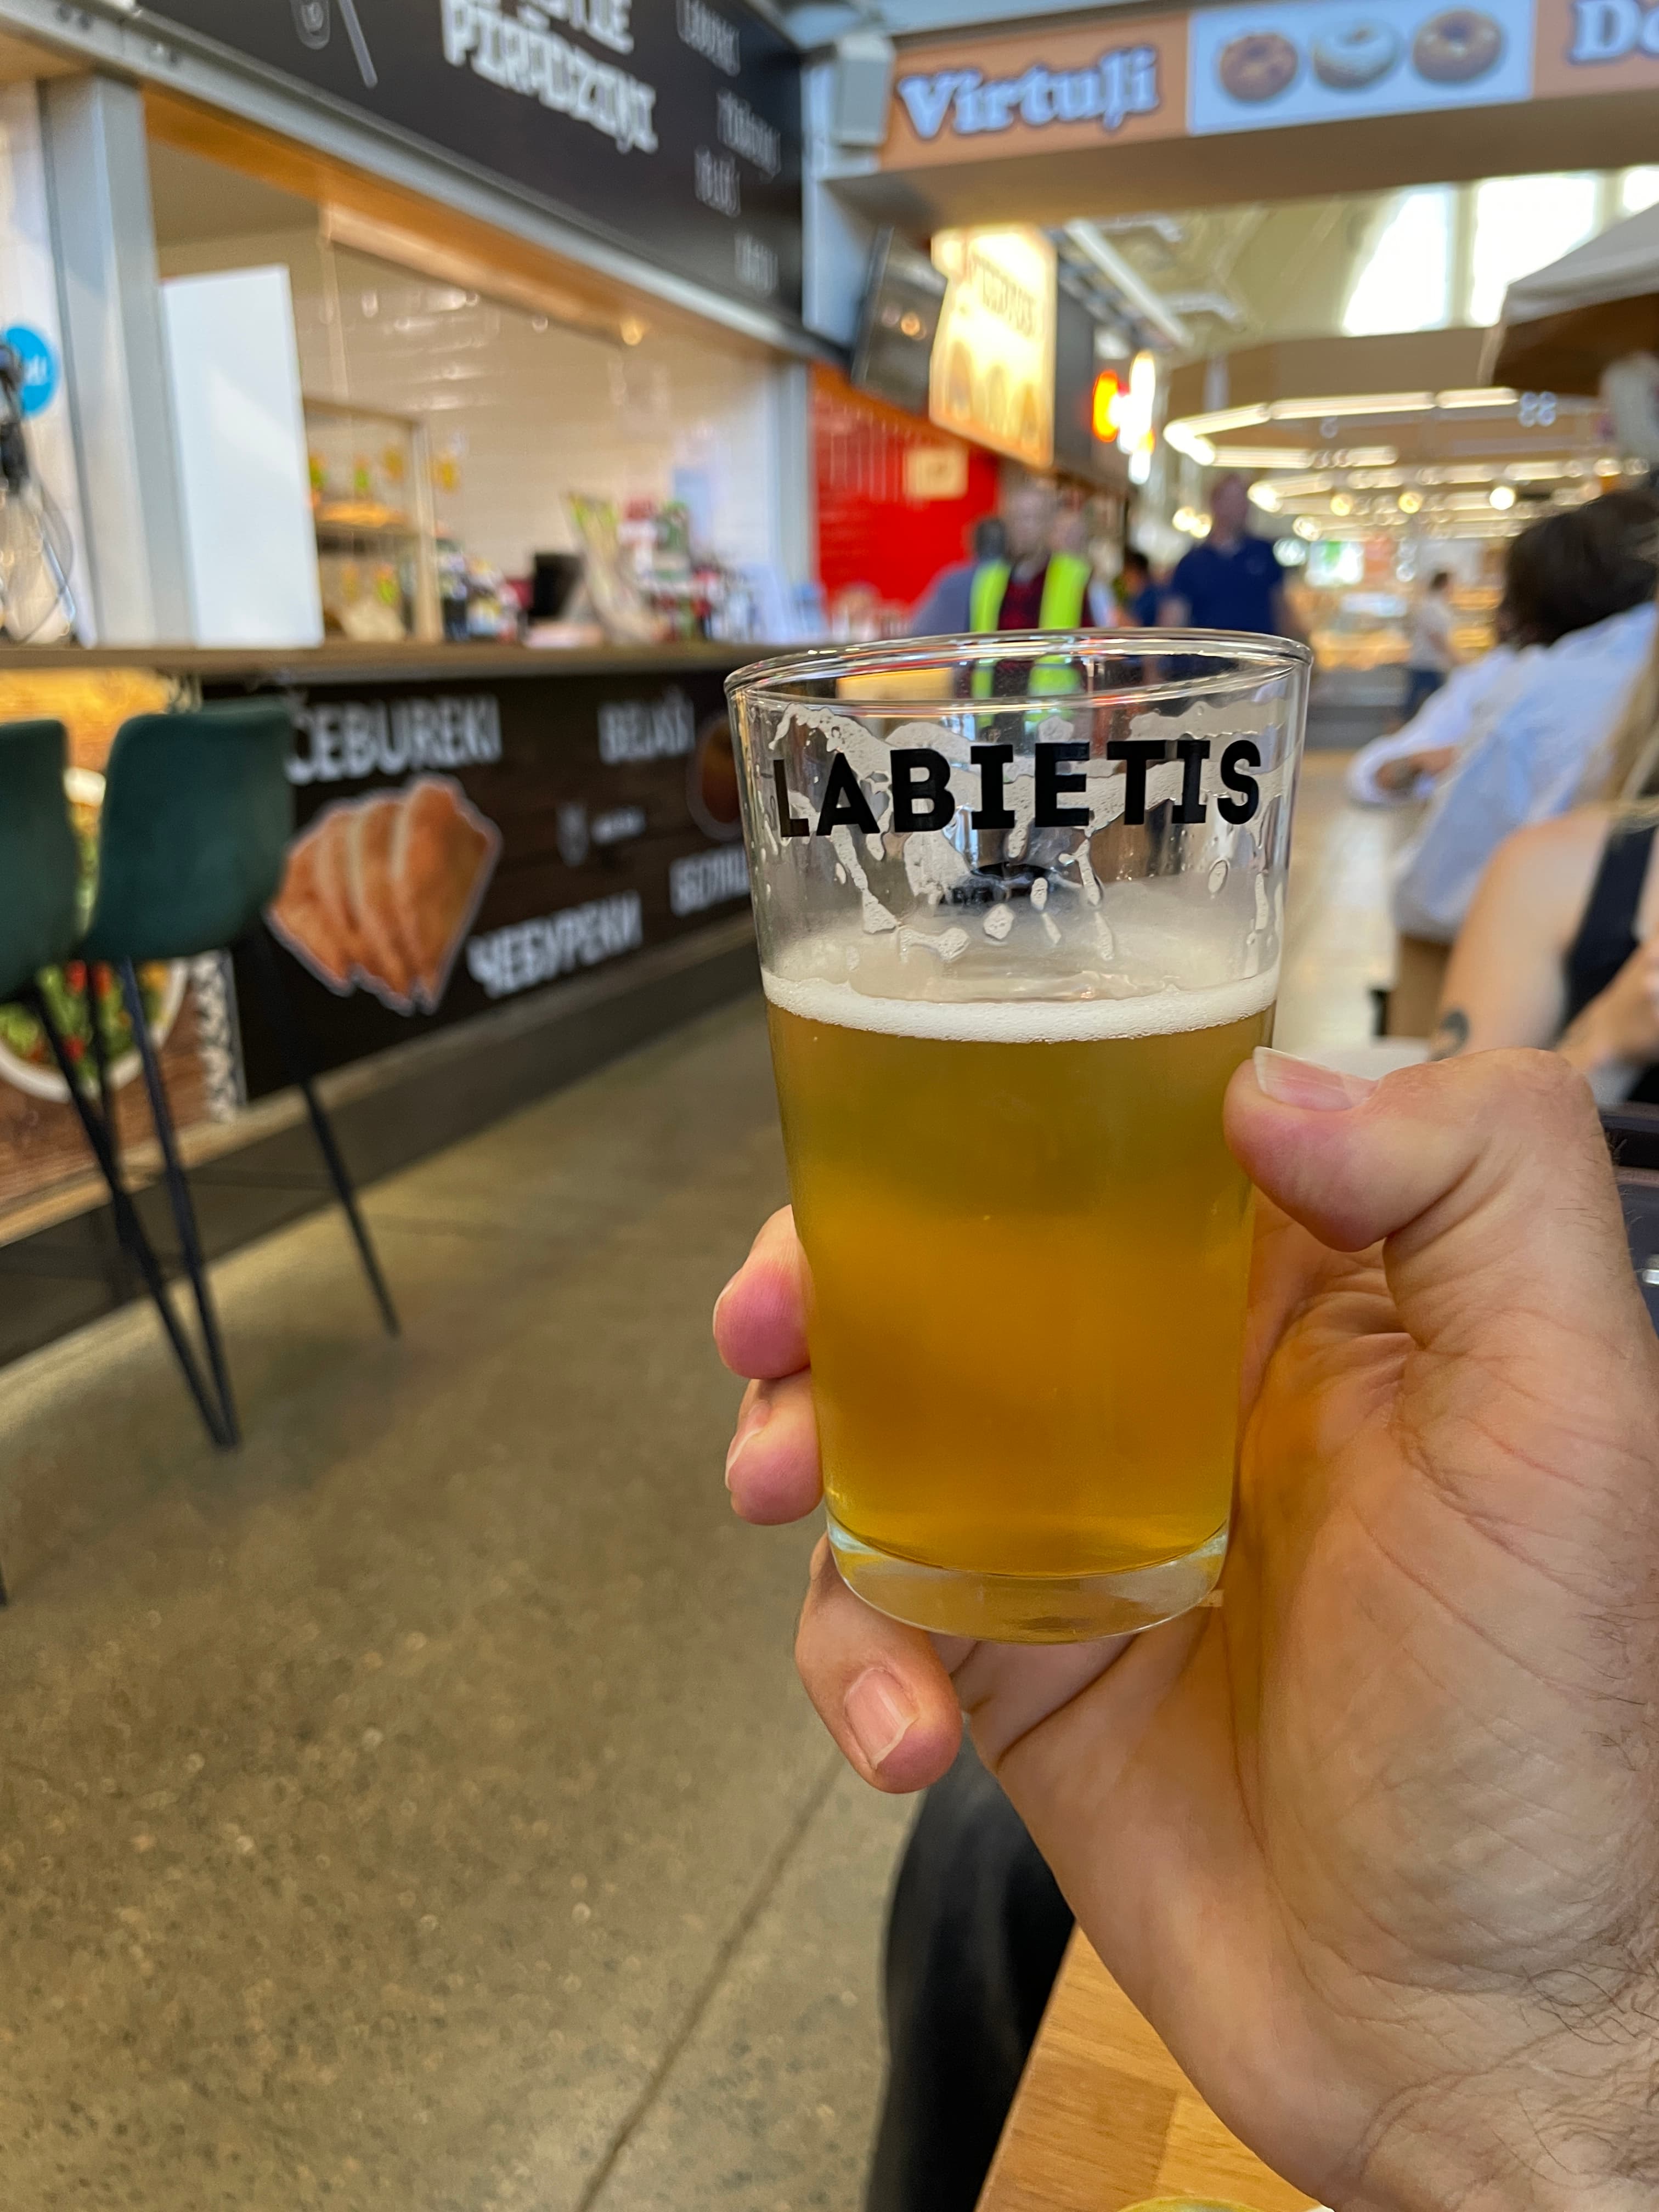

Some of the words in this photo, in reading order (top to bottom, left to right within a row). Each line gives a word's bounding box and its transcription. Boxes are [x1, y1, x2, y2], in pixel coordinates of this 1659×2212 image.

[898, 45, 1159, 139] Virtuļi
[773, 738, 1262, 838] LABIETIS
[467, 889, 643, 1000] ЧЕБУРЕКИ
